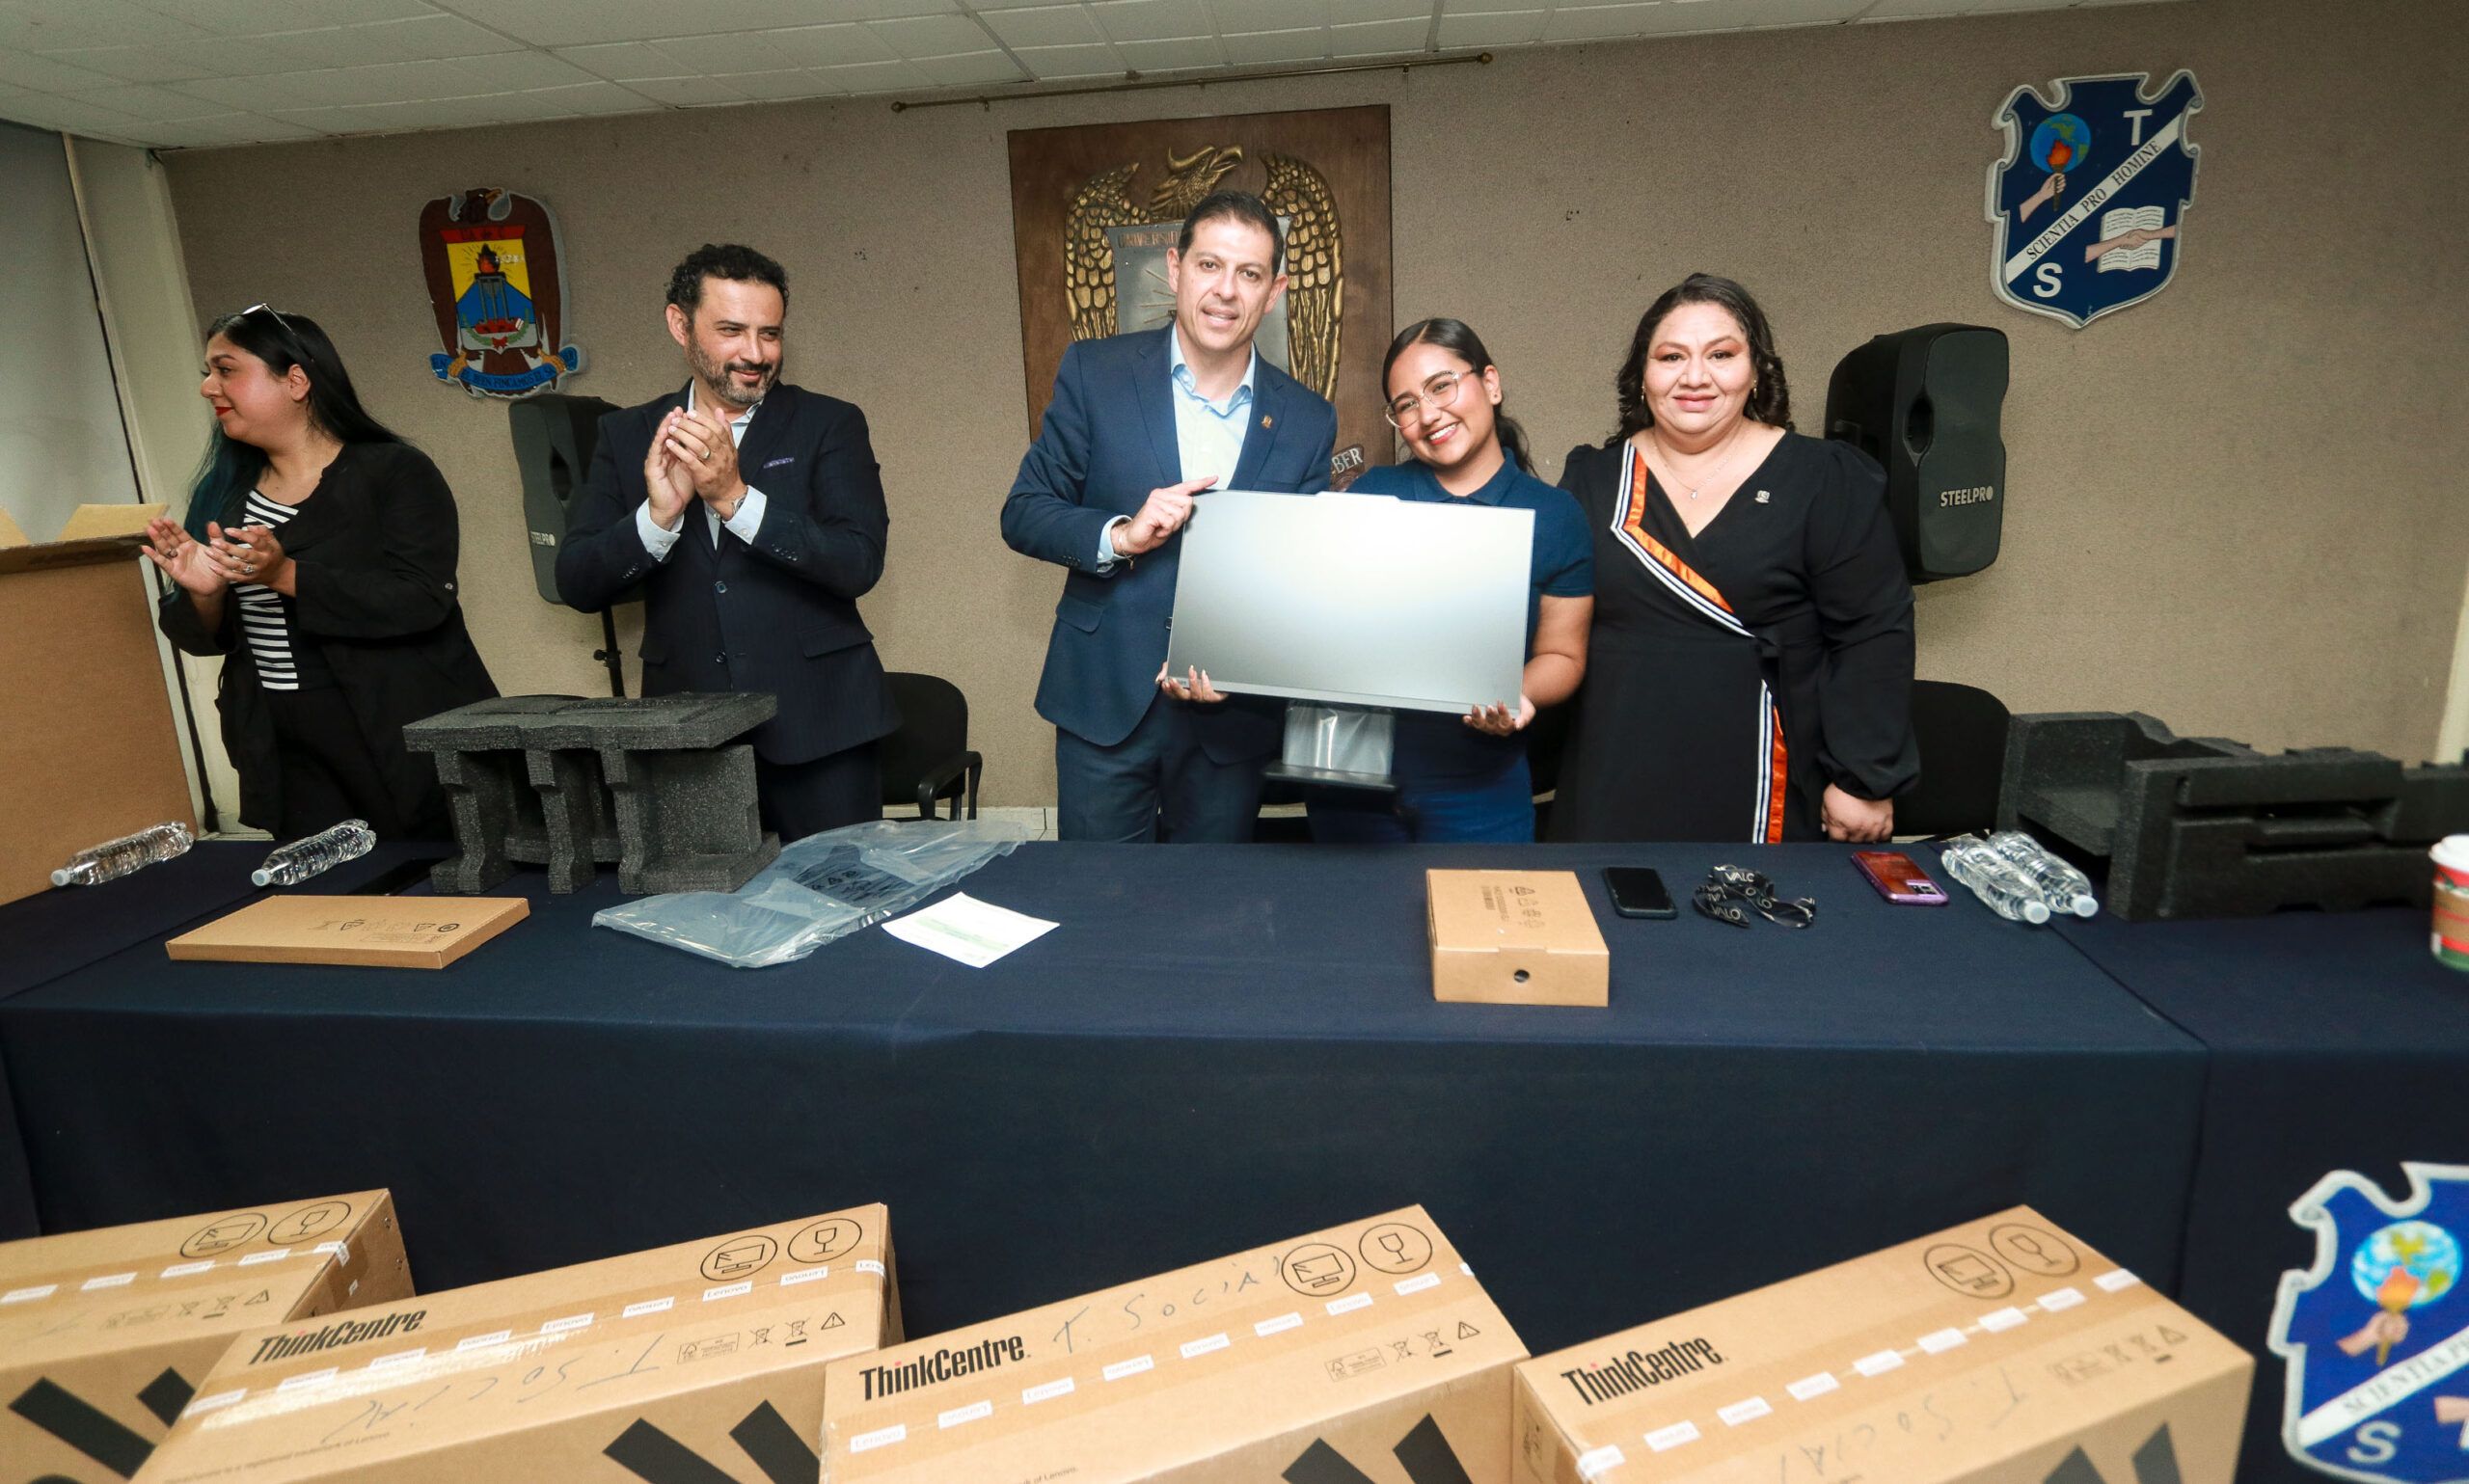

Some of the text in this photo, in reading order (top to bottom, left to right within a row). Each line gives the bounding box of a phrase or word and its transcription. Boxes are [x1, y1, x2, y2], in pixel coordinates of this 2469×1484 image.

[2123, 109, 2153, 146] T
[2026, 140, 2161, 260] SCIENTIA PRO HOMINE
[2033, 262, 2063, 298] S
[1331, 447, 1364, 473] BER
[1940, 486, 1994, 507] STEELPRO
[2347, 1419, 2402, 1464] S
